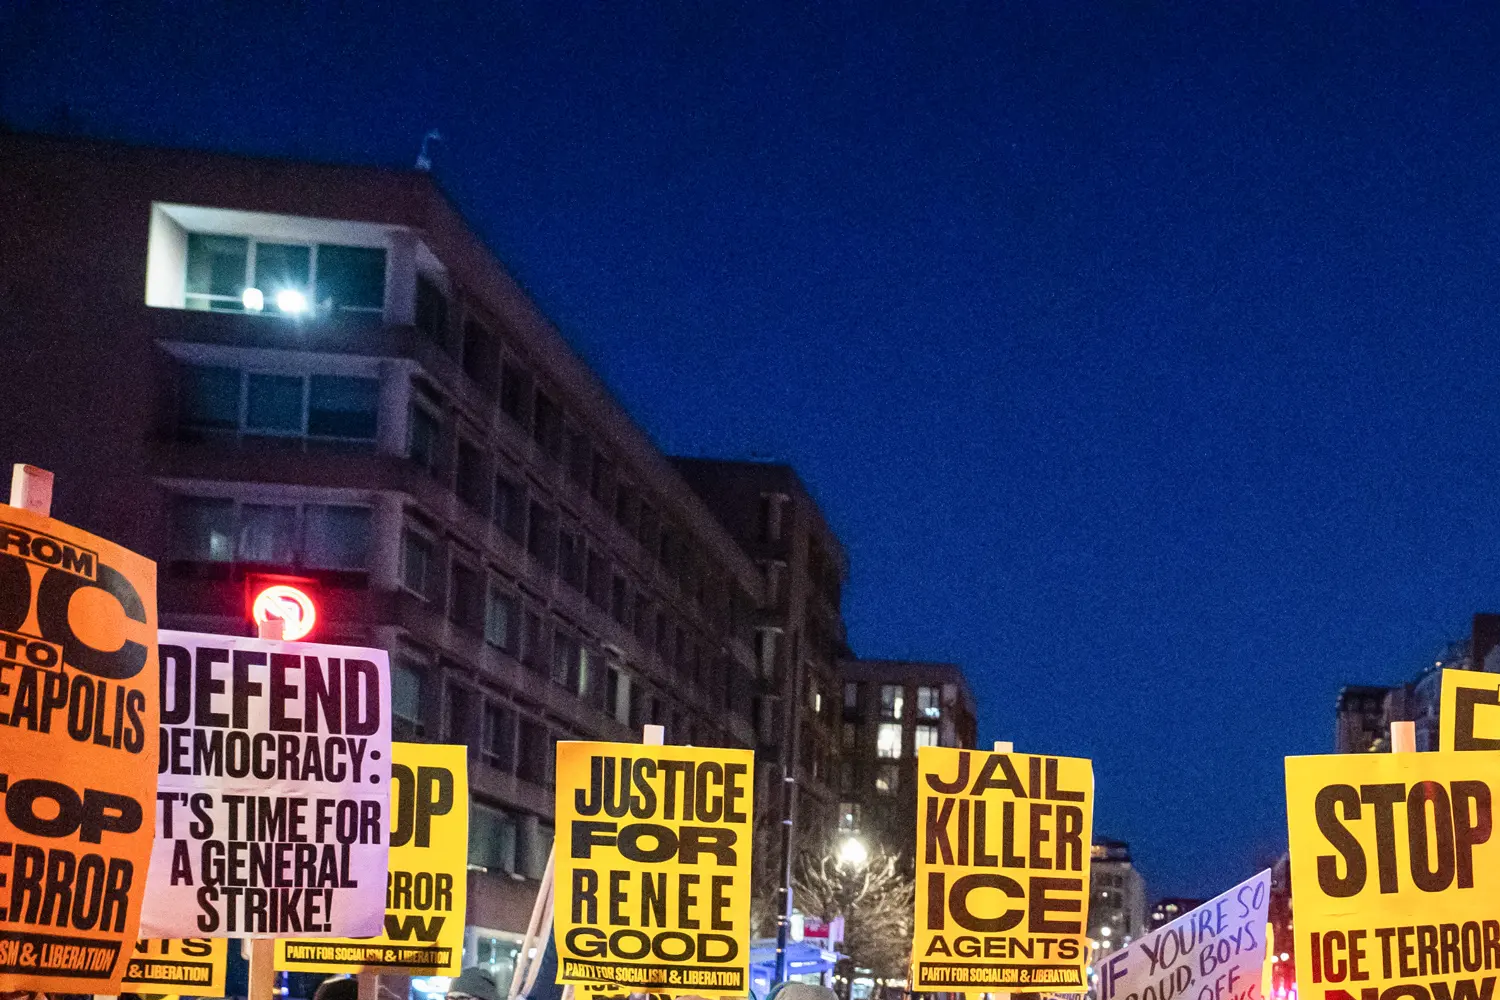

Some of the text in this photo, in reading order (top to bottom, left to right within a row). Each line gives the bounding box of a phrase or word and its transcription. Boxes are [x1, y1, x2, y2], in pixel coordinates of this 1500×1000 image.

[0, 526, 93, 577] ROM
[0, 636, 58, 668] TO
[0, 661, 146, 754] EAPOLIS
[158, 644, 381, 736] DEFEND
[574, 755, 748, 824] JUSTICE
[925, 752, 1085, 802] JAIL
[0, 773, 143, 844] OP
[157, 792, 382, 845] T'S TIME FOR
[390, 763, 454, 848] OP
[571, 820, 738, 866] FOR
[925, 796, 1083, 871] KILLER
[1315, 780, 1493, 898] STOP
[0, 841, 134, 933] ERROR
[170, 839, 358, 888] A GENERAL
[196, 886, 334, 933] STRIKE!
[386, 871, 453, 911] ROR
[571, 868, 734, 931] RENEE
[927, 872, 1083, 934] ICE
[1237, 881, 1265, 918] SO
[20, 942, 36, 967] &
[41, 943, 115, 972] LIBERATION
[287, 946, 449, 964] PARTY FOR SOCIALISM & LIBERATION
[565, 927, 739, 963] GOOD
[925, 935, 1080, 960] AGENTS
[1310, 929, 1370, 983] ICE
[128, 964, 209, 982] & LIBERATION
[565, 962, 741, 987] PARTY FOR SOCIALISM & LIBERATION
[921, 966, 1081, 984] PARTY FOR SOCIALISM & LIBERATION
